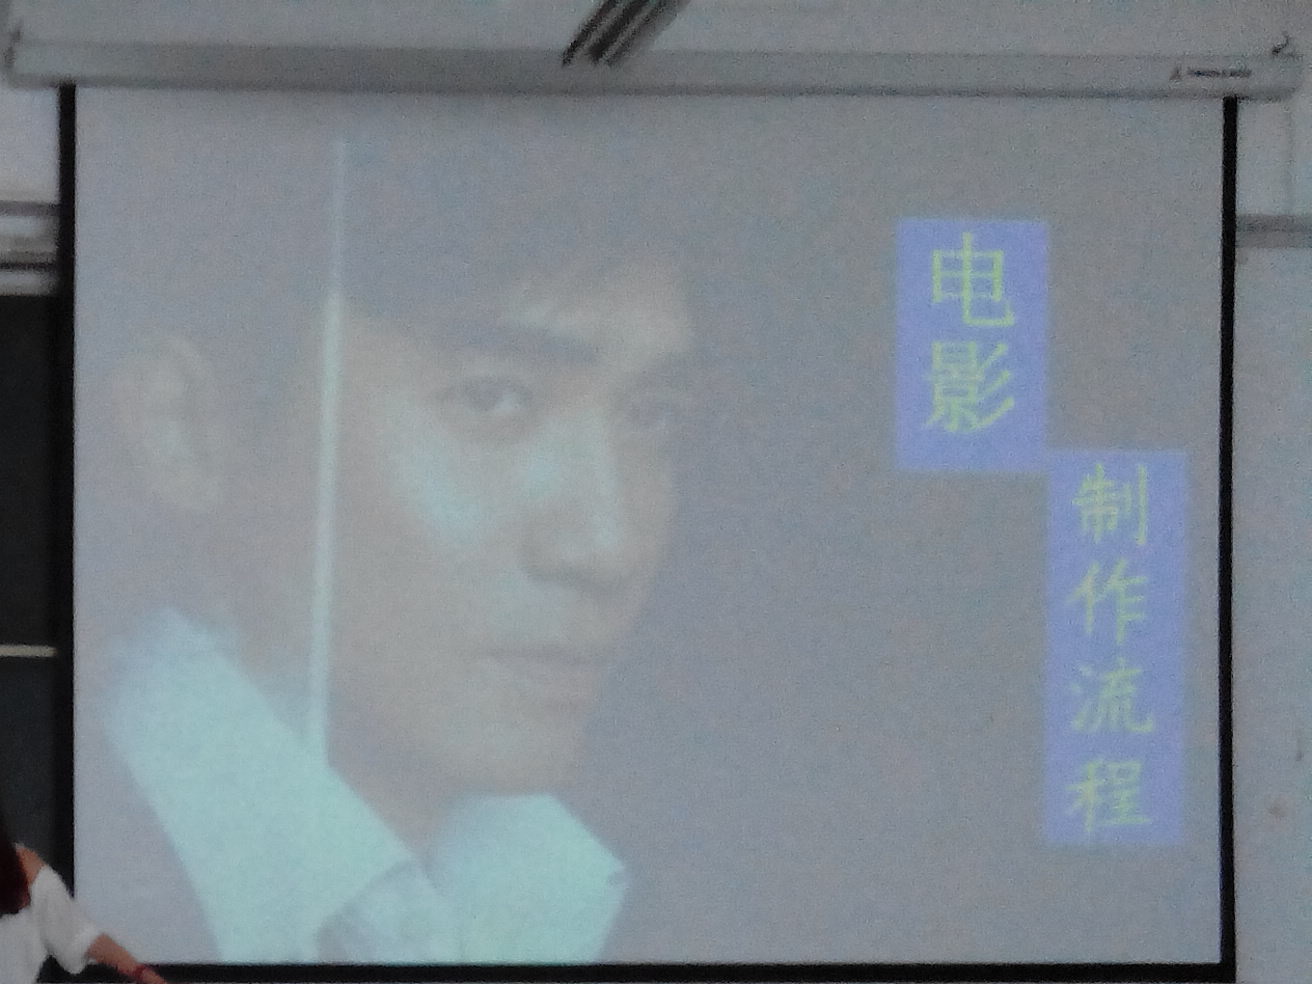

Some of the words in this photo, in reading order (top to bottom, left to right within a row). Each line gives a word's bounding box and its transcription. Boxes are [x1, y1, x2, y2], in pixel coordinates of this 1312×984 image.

[922, 231, 1015, 433] 电影
[1066, 462, 1154, 836] 制作流程
